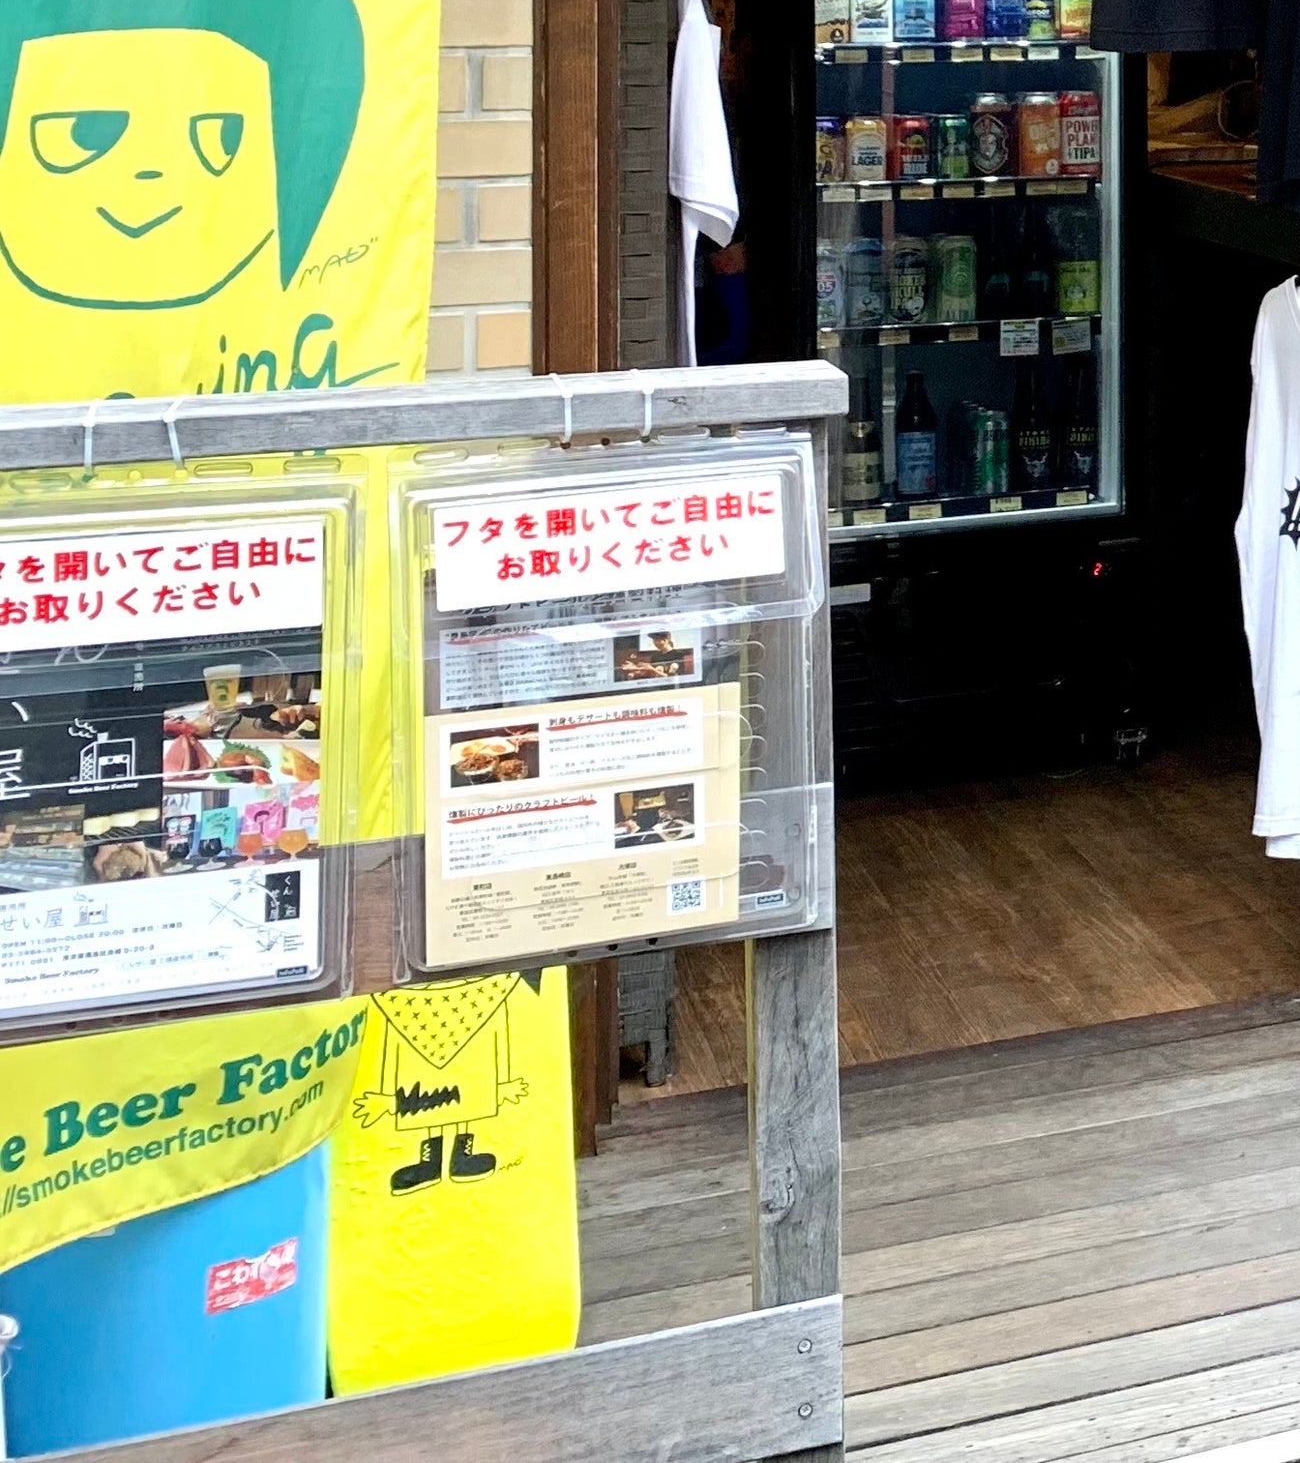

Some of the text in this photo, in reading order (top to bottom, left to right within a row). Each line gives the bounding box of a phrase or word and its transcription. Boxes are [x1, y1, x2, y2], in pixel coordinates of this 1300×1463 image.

[851, 154, 883, 167] LAGER
[442, 485, 778, 548] フタを開いてご自由に
[495, 530, 730, 582] お取りください
[62, 966, 101, 979] Factory
[43, 1080, 197, 1142] Beer
